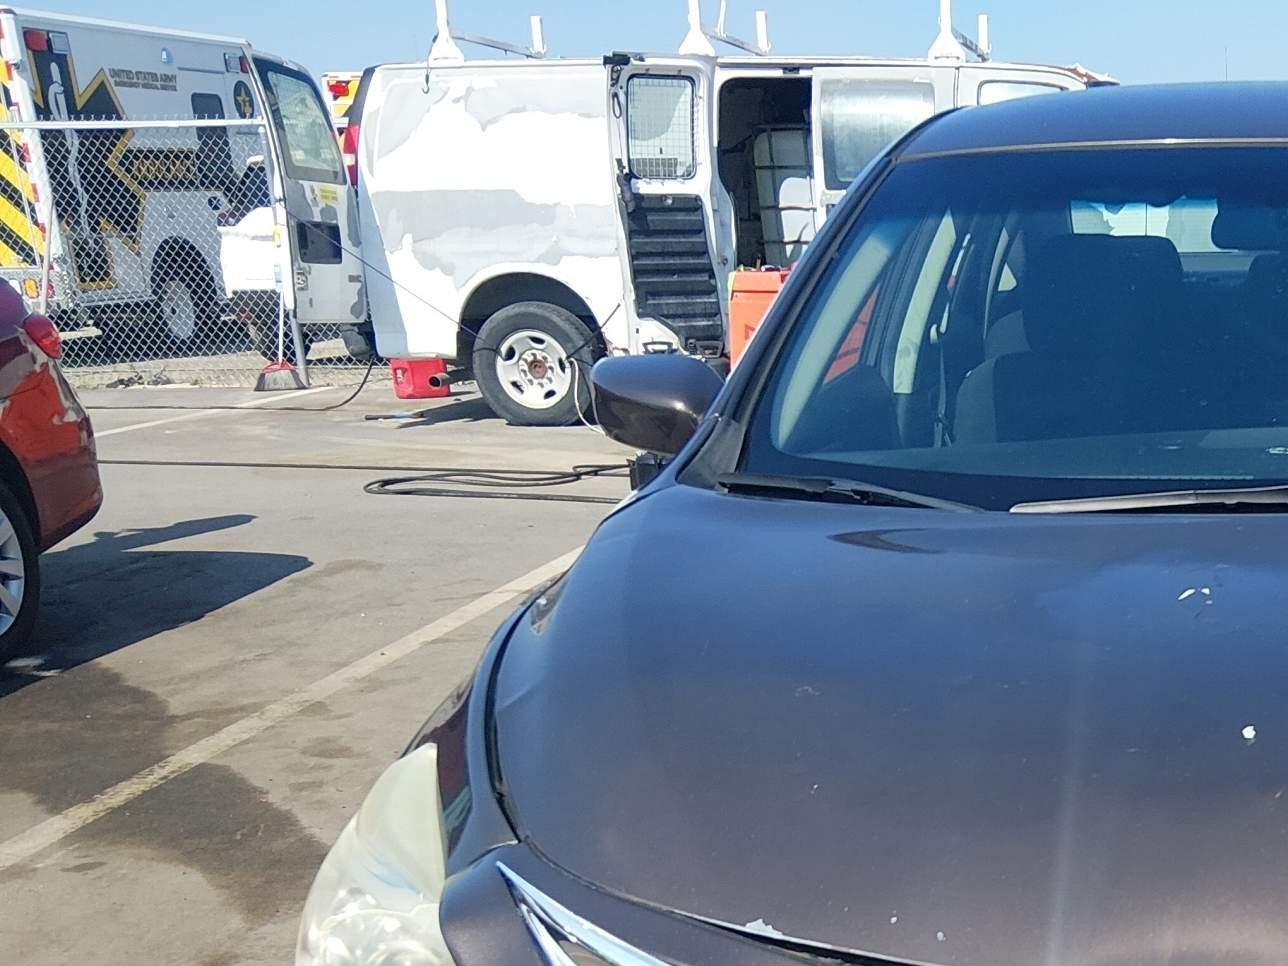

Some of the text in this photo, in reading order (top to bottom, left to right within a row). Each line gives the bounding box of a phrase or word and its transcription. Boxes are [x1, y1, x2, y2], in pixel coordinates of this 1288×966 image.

[108, 68, 177, 83] UNITED STATES ARMY
